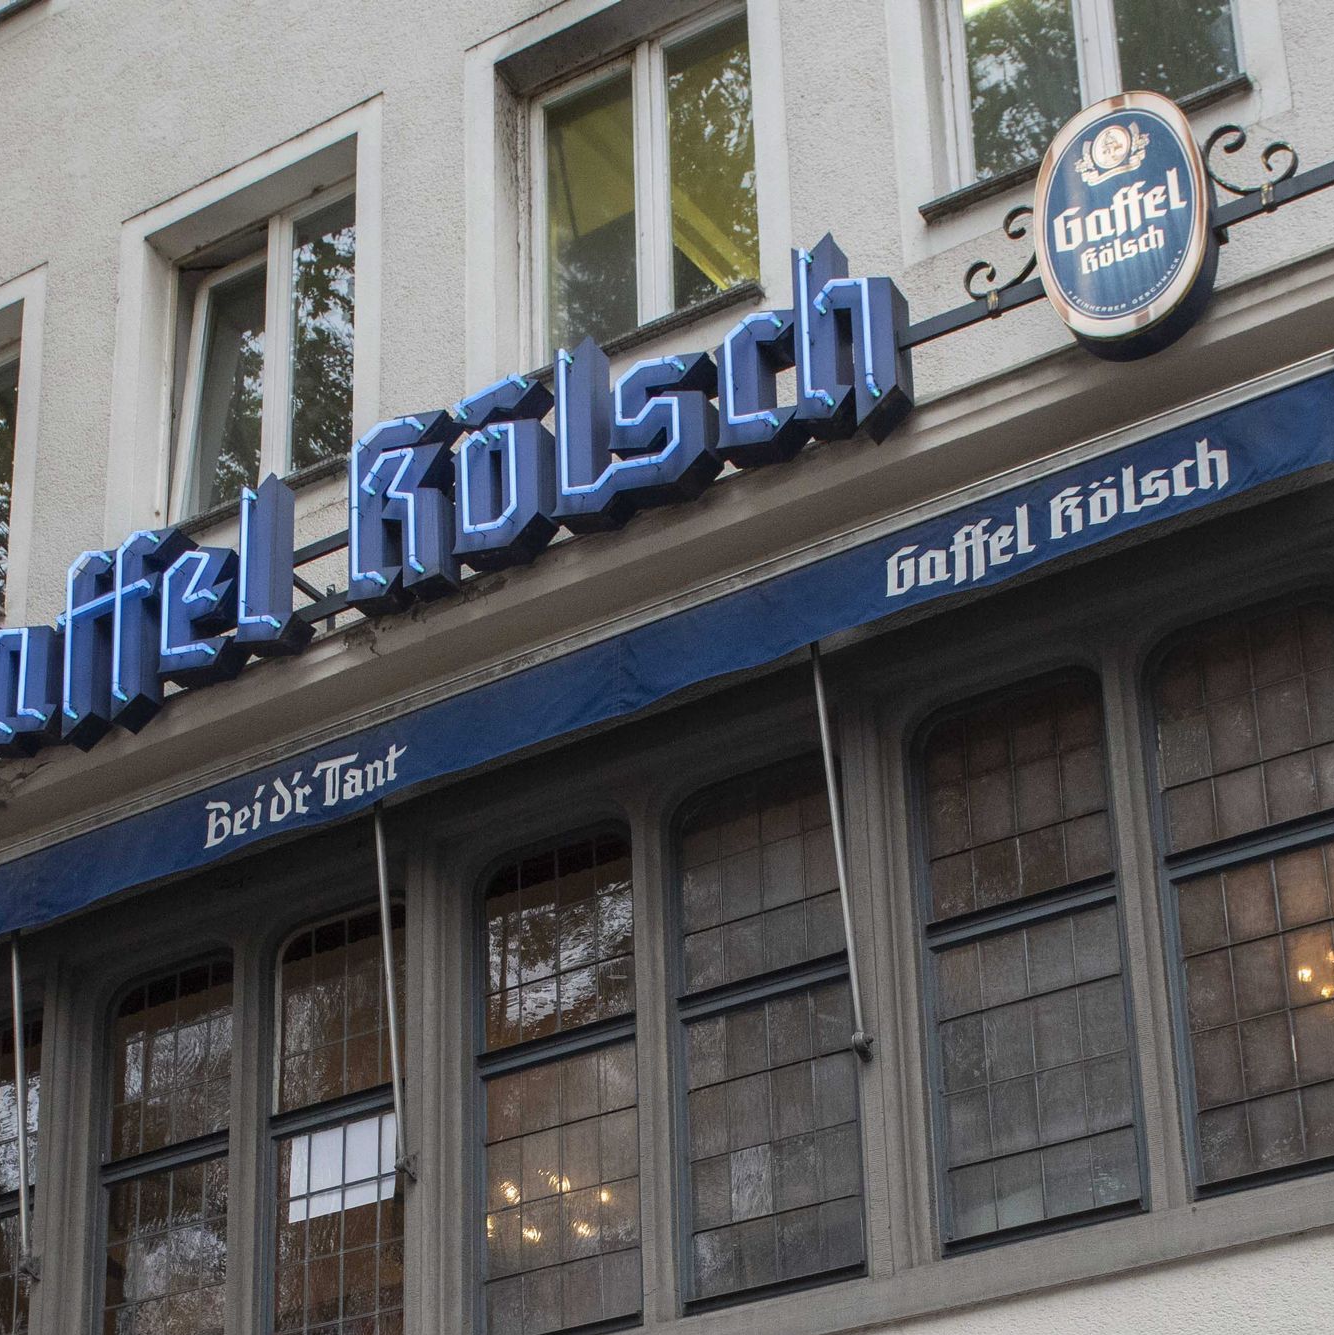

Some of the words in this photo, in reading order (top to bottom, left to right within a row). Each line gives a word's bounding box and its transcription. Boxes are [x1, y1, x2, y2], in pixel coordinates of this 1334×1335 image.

[1053, 167, 1188, 253] Gaffel
[1081, 225, 1165, 275] Kölsch
[348, 232, 914, 614] Kölsch
[886, 505, 1036, 598] Gaffel
[1049, 438, 1229, 540] Kölsch
[204, 786, 264, 850] Bei
[312, 744, 408, 807] Tant
